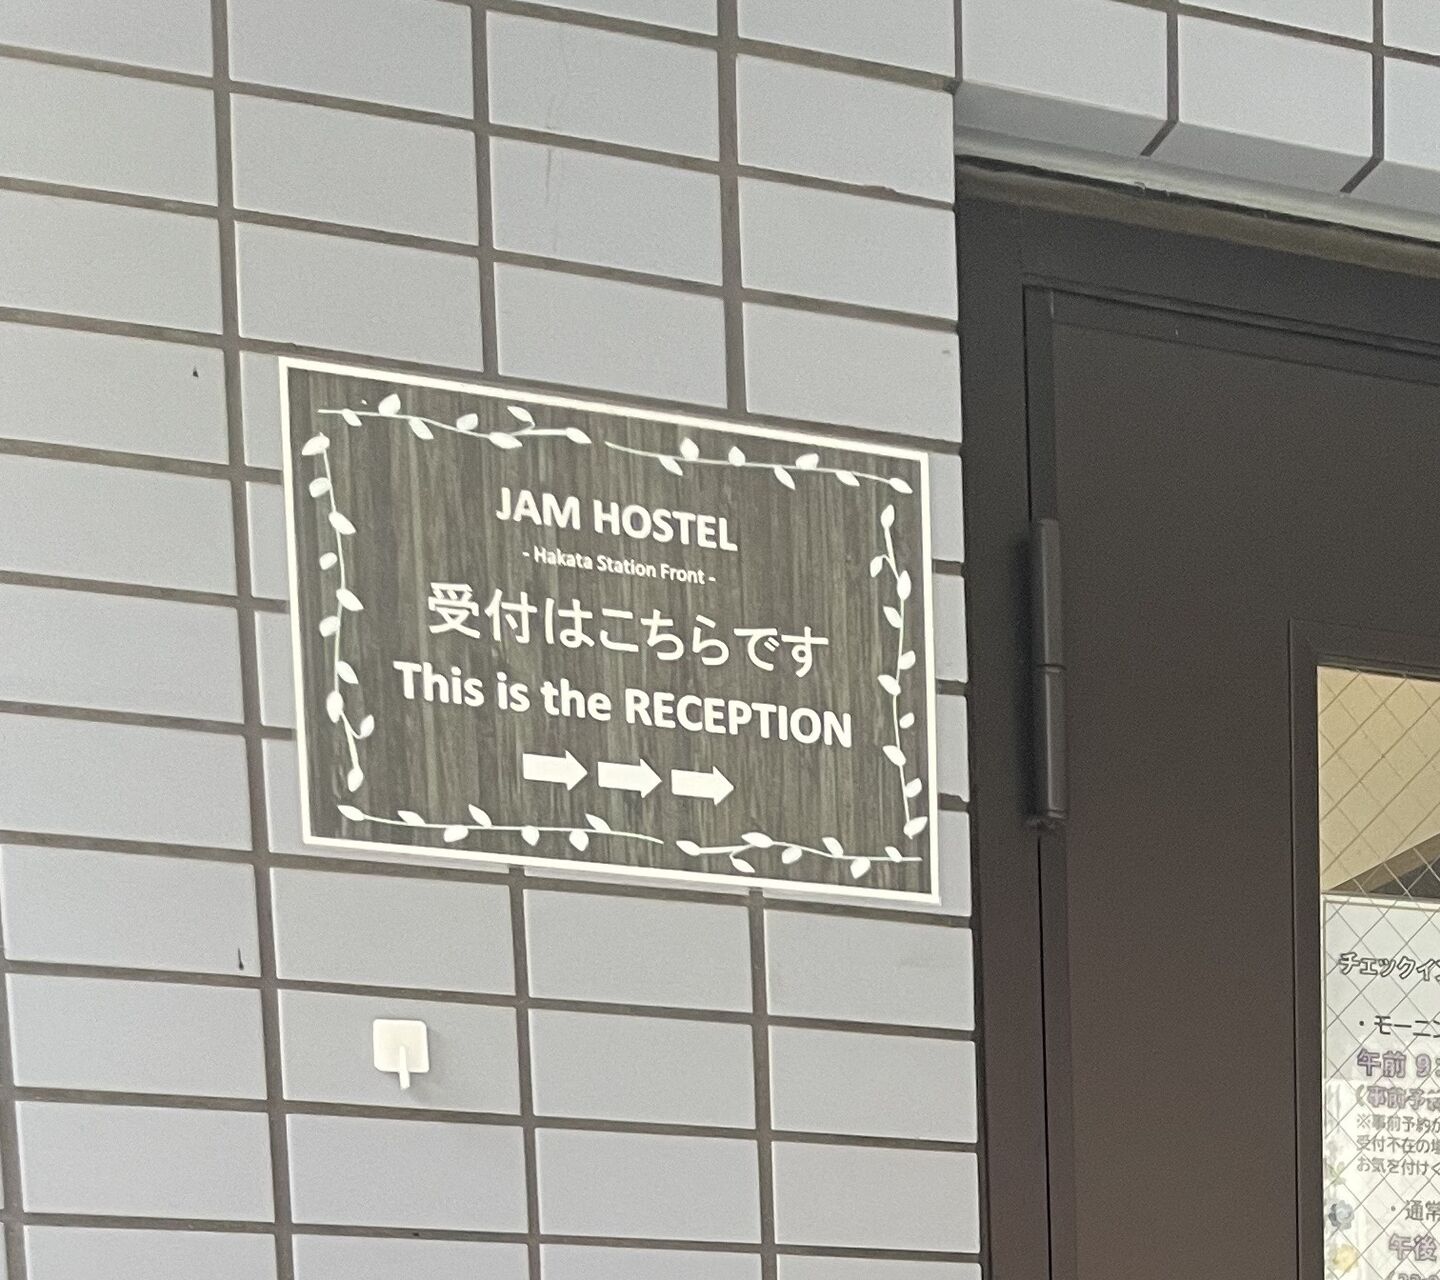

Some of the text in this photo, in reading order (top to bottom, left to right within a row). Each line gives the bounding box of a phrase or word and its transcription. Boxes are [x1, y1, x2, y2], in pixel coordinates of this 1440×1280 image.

[496, 487, 739, 553] JAM HOSTEL
[533, 546, 705, 585] Hakata Station Front
[427, 581, 830, 678] 受付はこちらです
[394, 660, 853, 748] This is the RECEPTION
[1356, 1048, 1407, 1079] 午前
[1388, 1233, 1438, 1263] 午後
